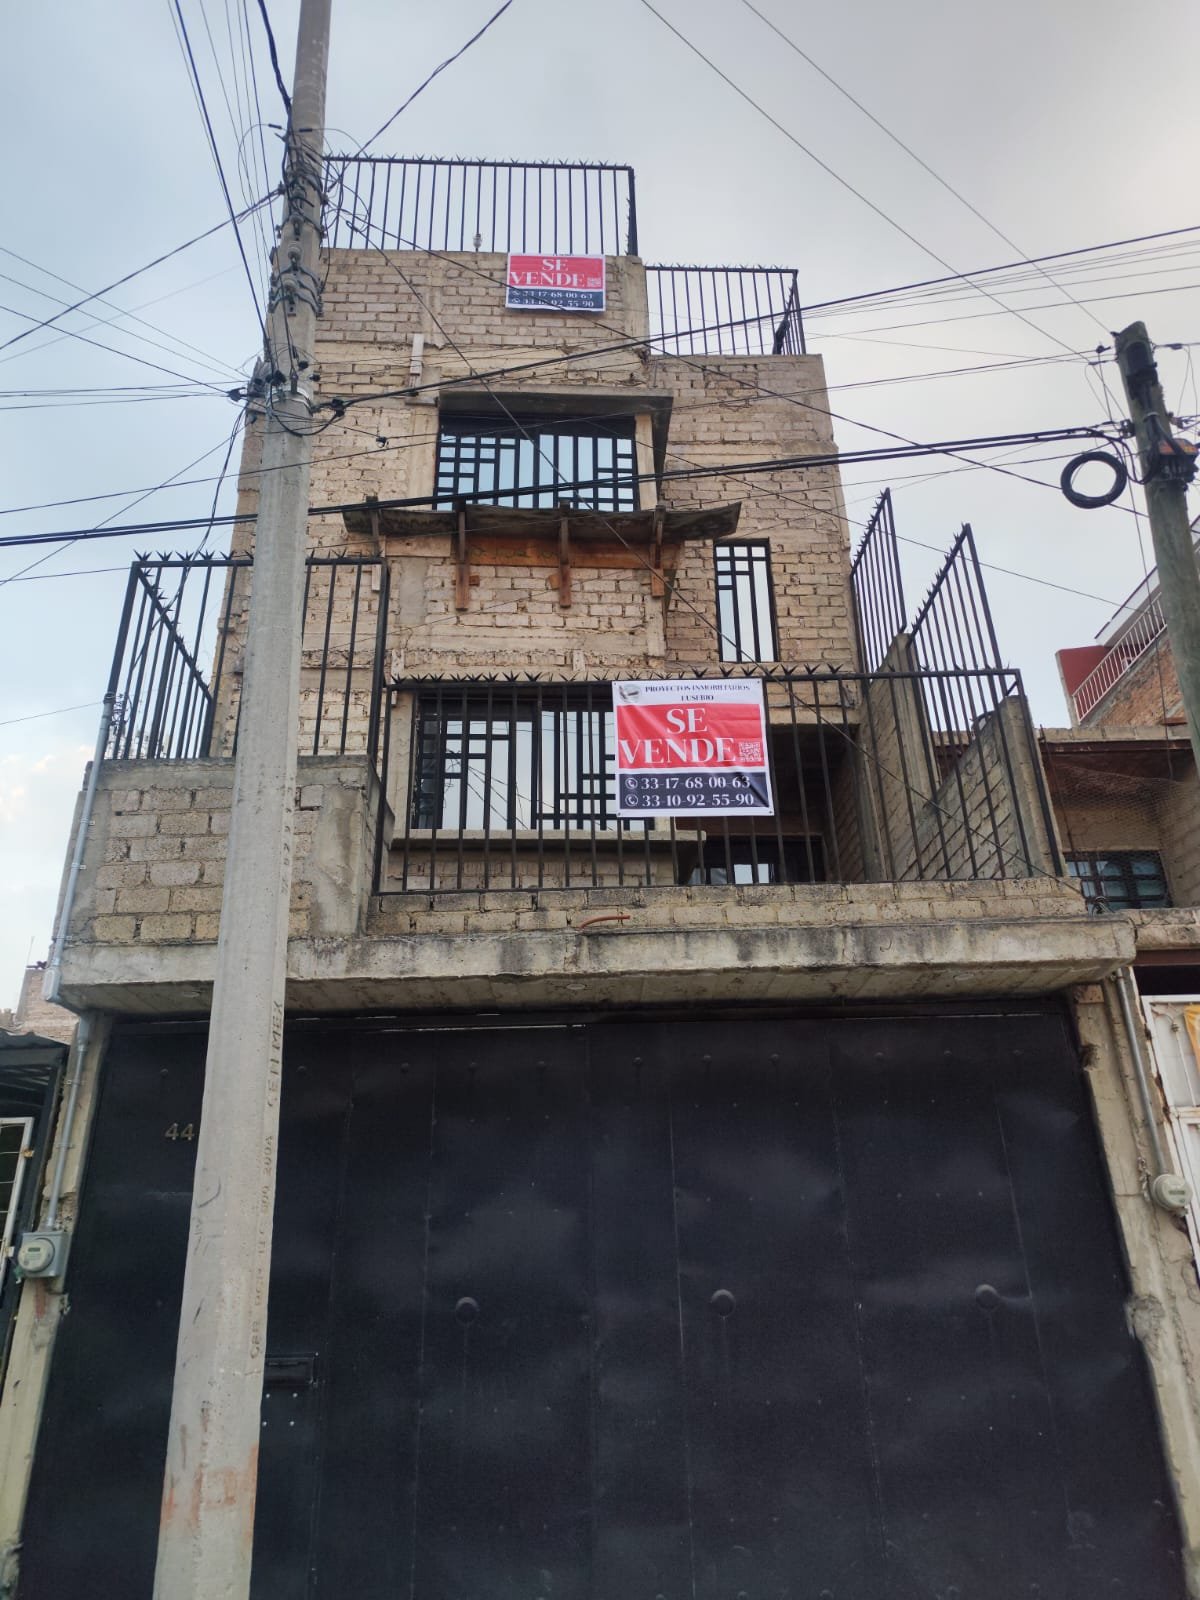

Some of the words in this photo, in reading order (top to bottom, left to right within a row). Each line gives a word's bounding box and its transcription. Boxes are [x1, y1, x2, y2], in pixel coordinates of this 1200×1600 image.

[542, 258, 568, 271] SE
[510, 271, 586, 288] VENDE
[645, 685, 691, 693] PROYECTOS
[666, 707, 708, 735] SE
[620, 737, 737, 765] VENDE
[641, 774, 751, 790] 33-17-68-00-63
[642, 793, 755, 808] 33-10-92-55-90
[164, 1122, 195, 1141] 44
